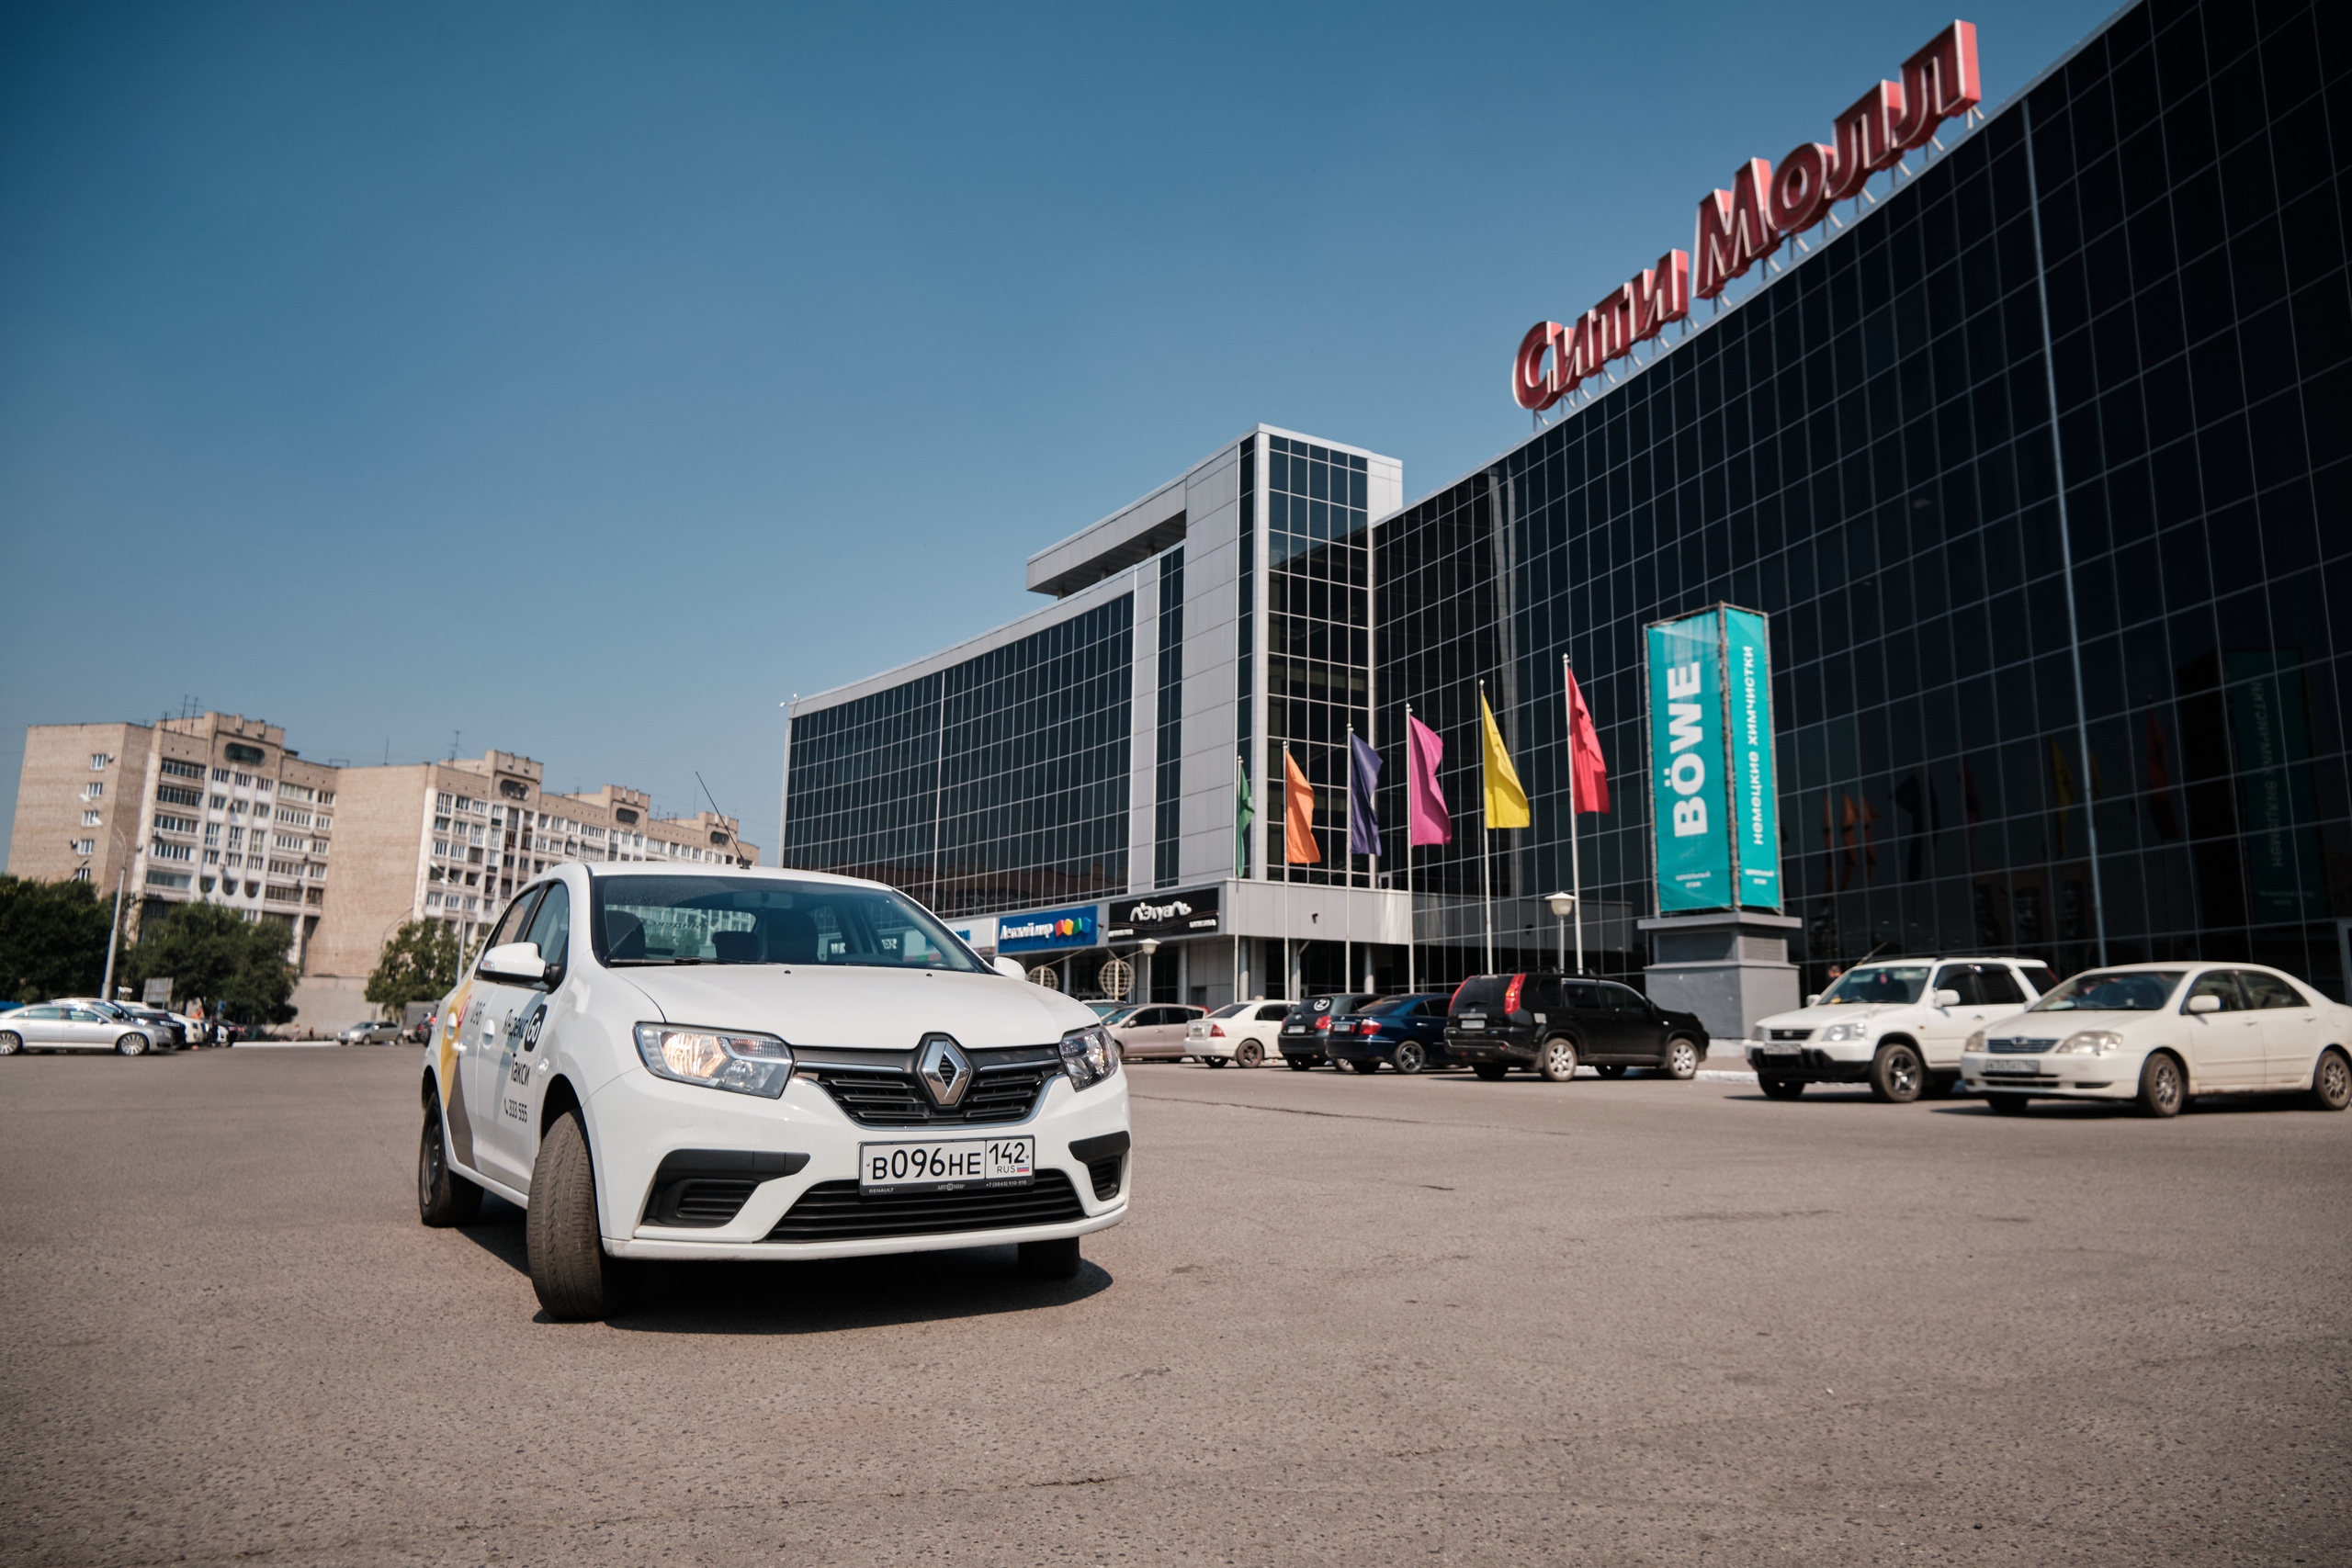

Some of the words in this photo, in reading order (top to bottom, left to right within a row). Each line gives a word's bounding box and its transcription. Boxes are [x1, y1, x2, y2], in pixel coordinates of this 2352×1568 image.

[1664, 660, 1708, 838] BÖWE
[989, 1142, 1026, 1165] 142
[996, 1165, 1016, 1174] RUS
